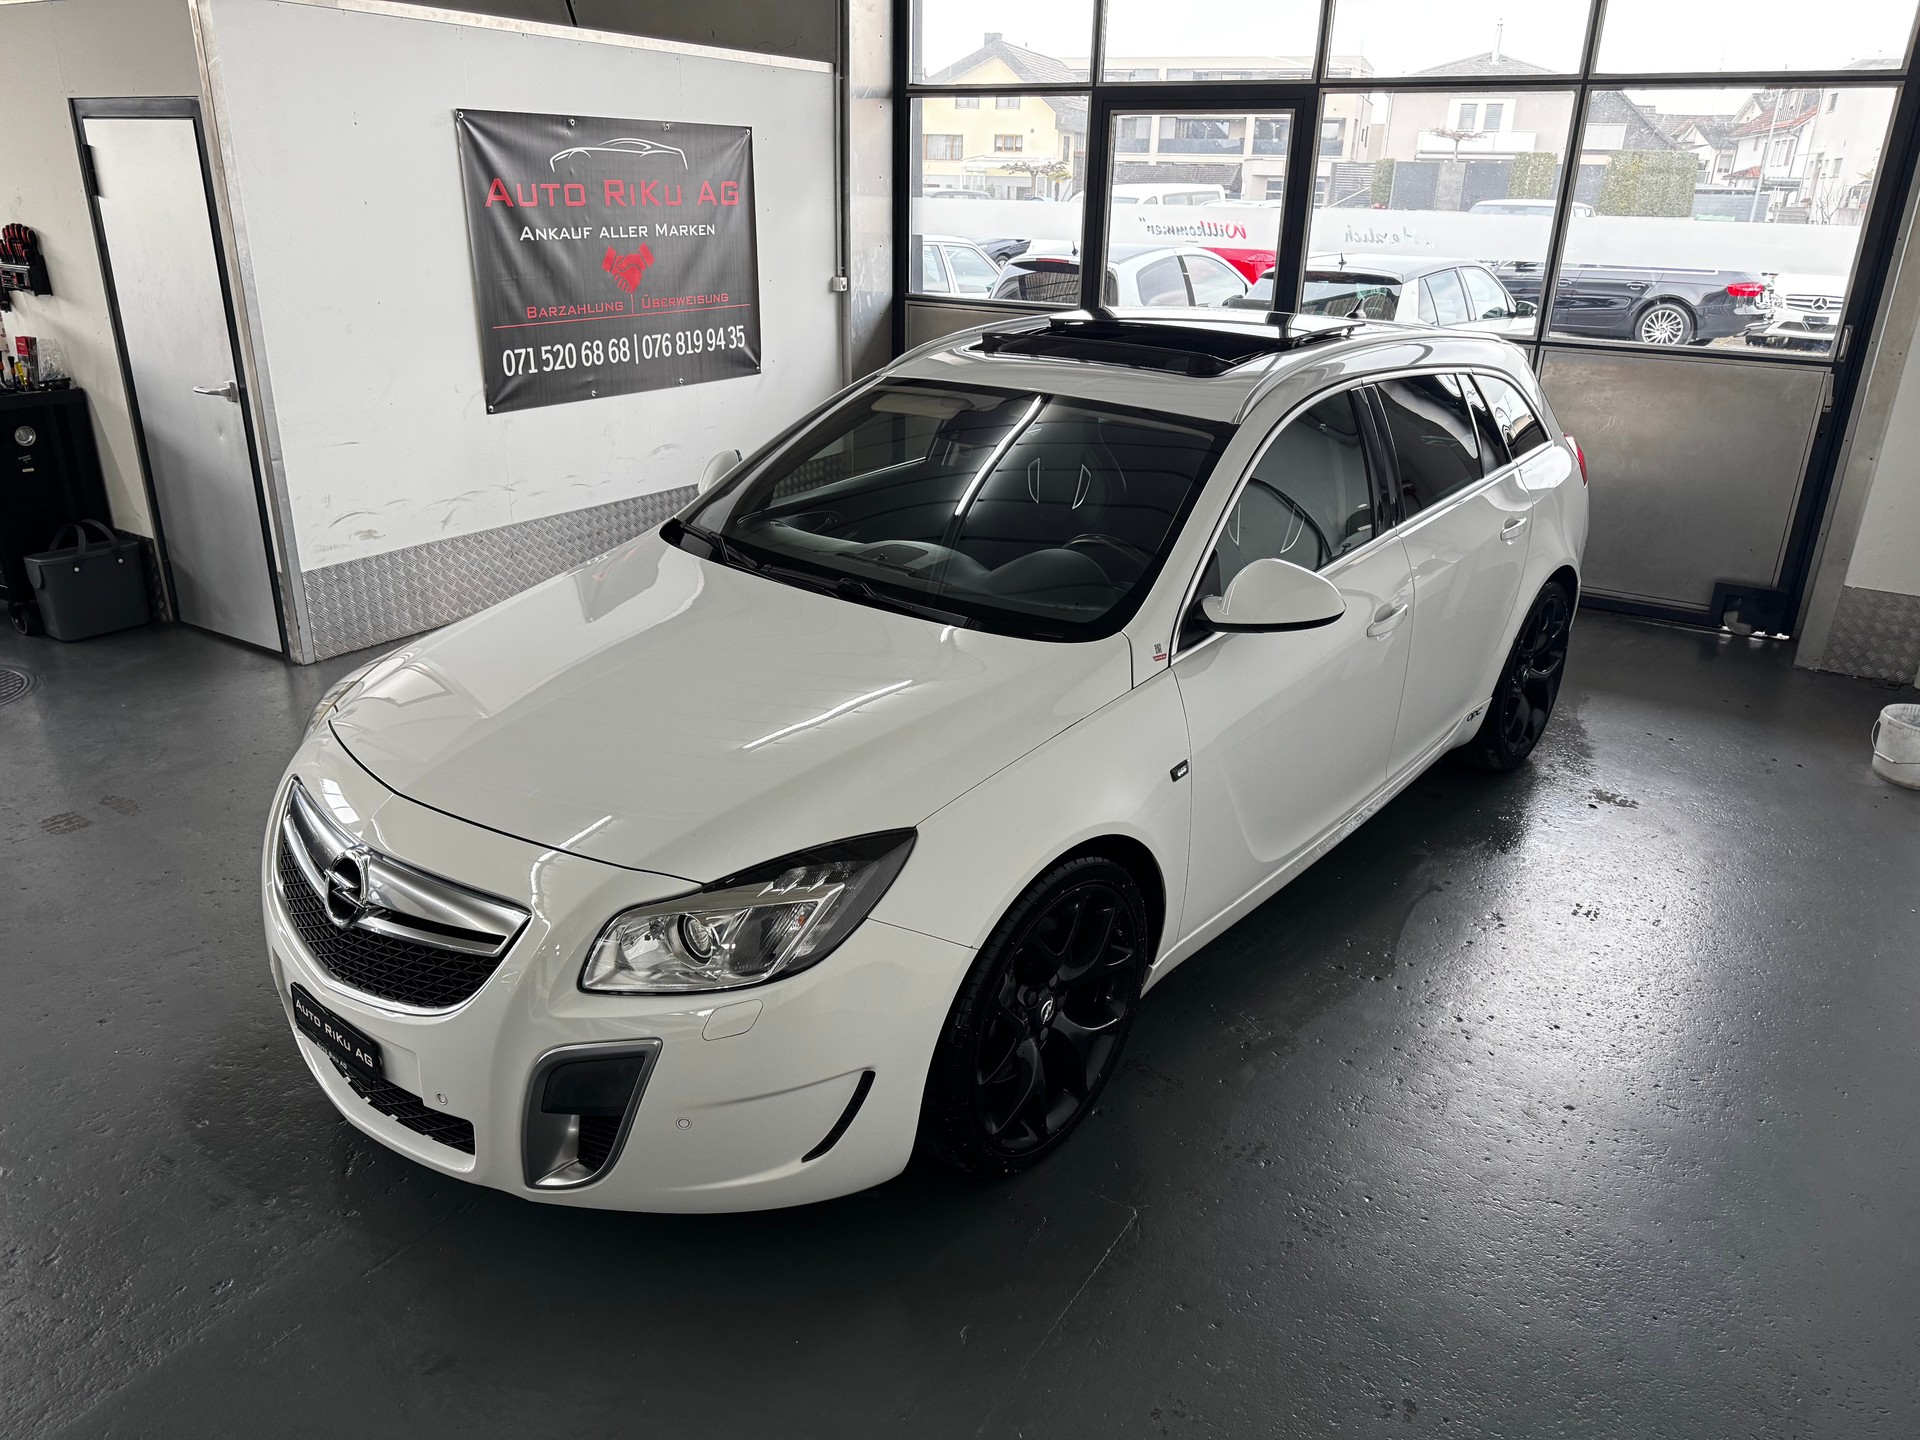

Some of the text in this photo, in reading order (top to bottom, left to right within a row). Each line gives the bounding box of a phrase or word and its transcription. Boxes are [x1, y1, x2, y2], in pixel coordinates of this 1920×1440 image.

[485, 178, 586, 207] AUTO
[697, 180, 739, 206] AG
[519, 223, 716, 241] ANKAUF ALLER MARKEN
[526, 293, 729, 319] BARZAHLUNG ÜBERWEISUNG
[502, 325, 746, 377] 071 520 68 68 076 819 94 35
[296, 999, 321, 1027] AUTO
[324, 1022, 351, 1051] RIKU
[355, 1047, 373, 1068] AG
